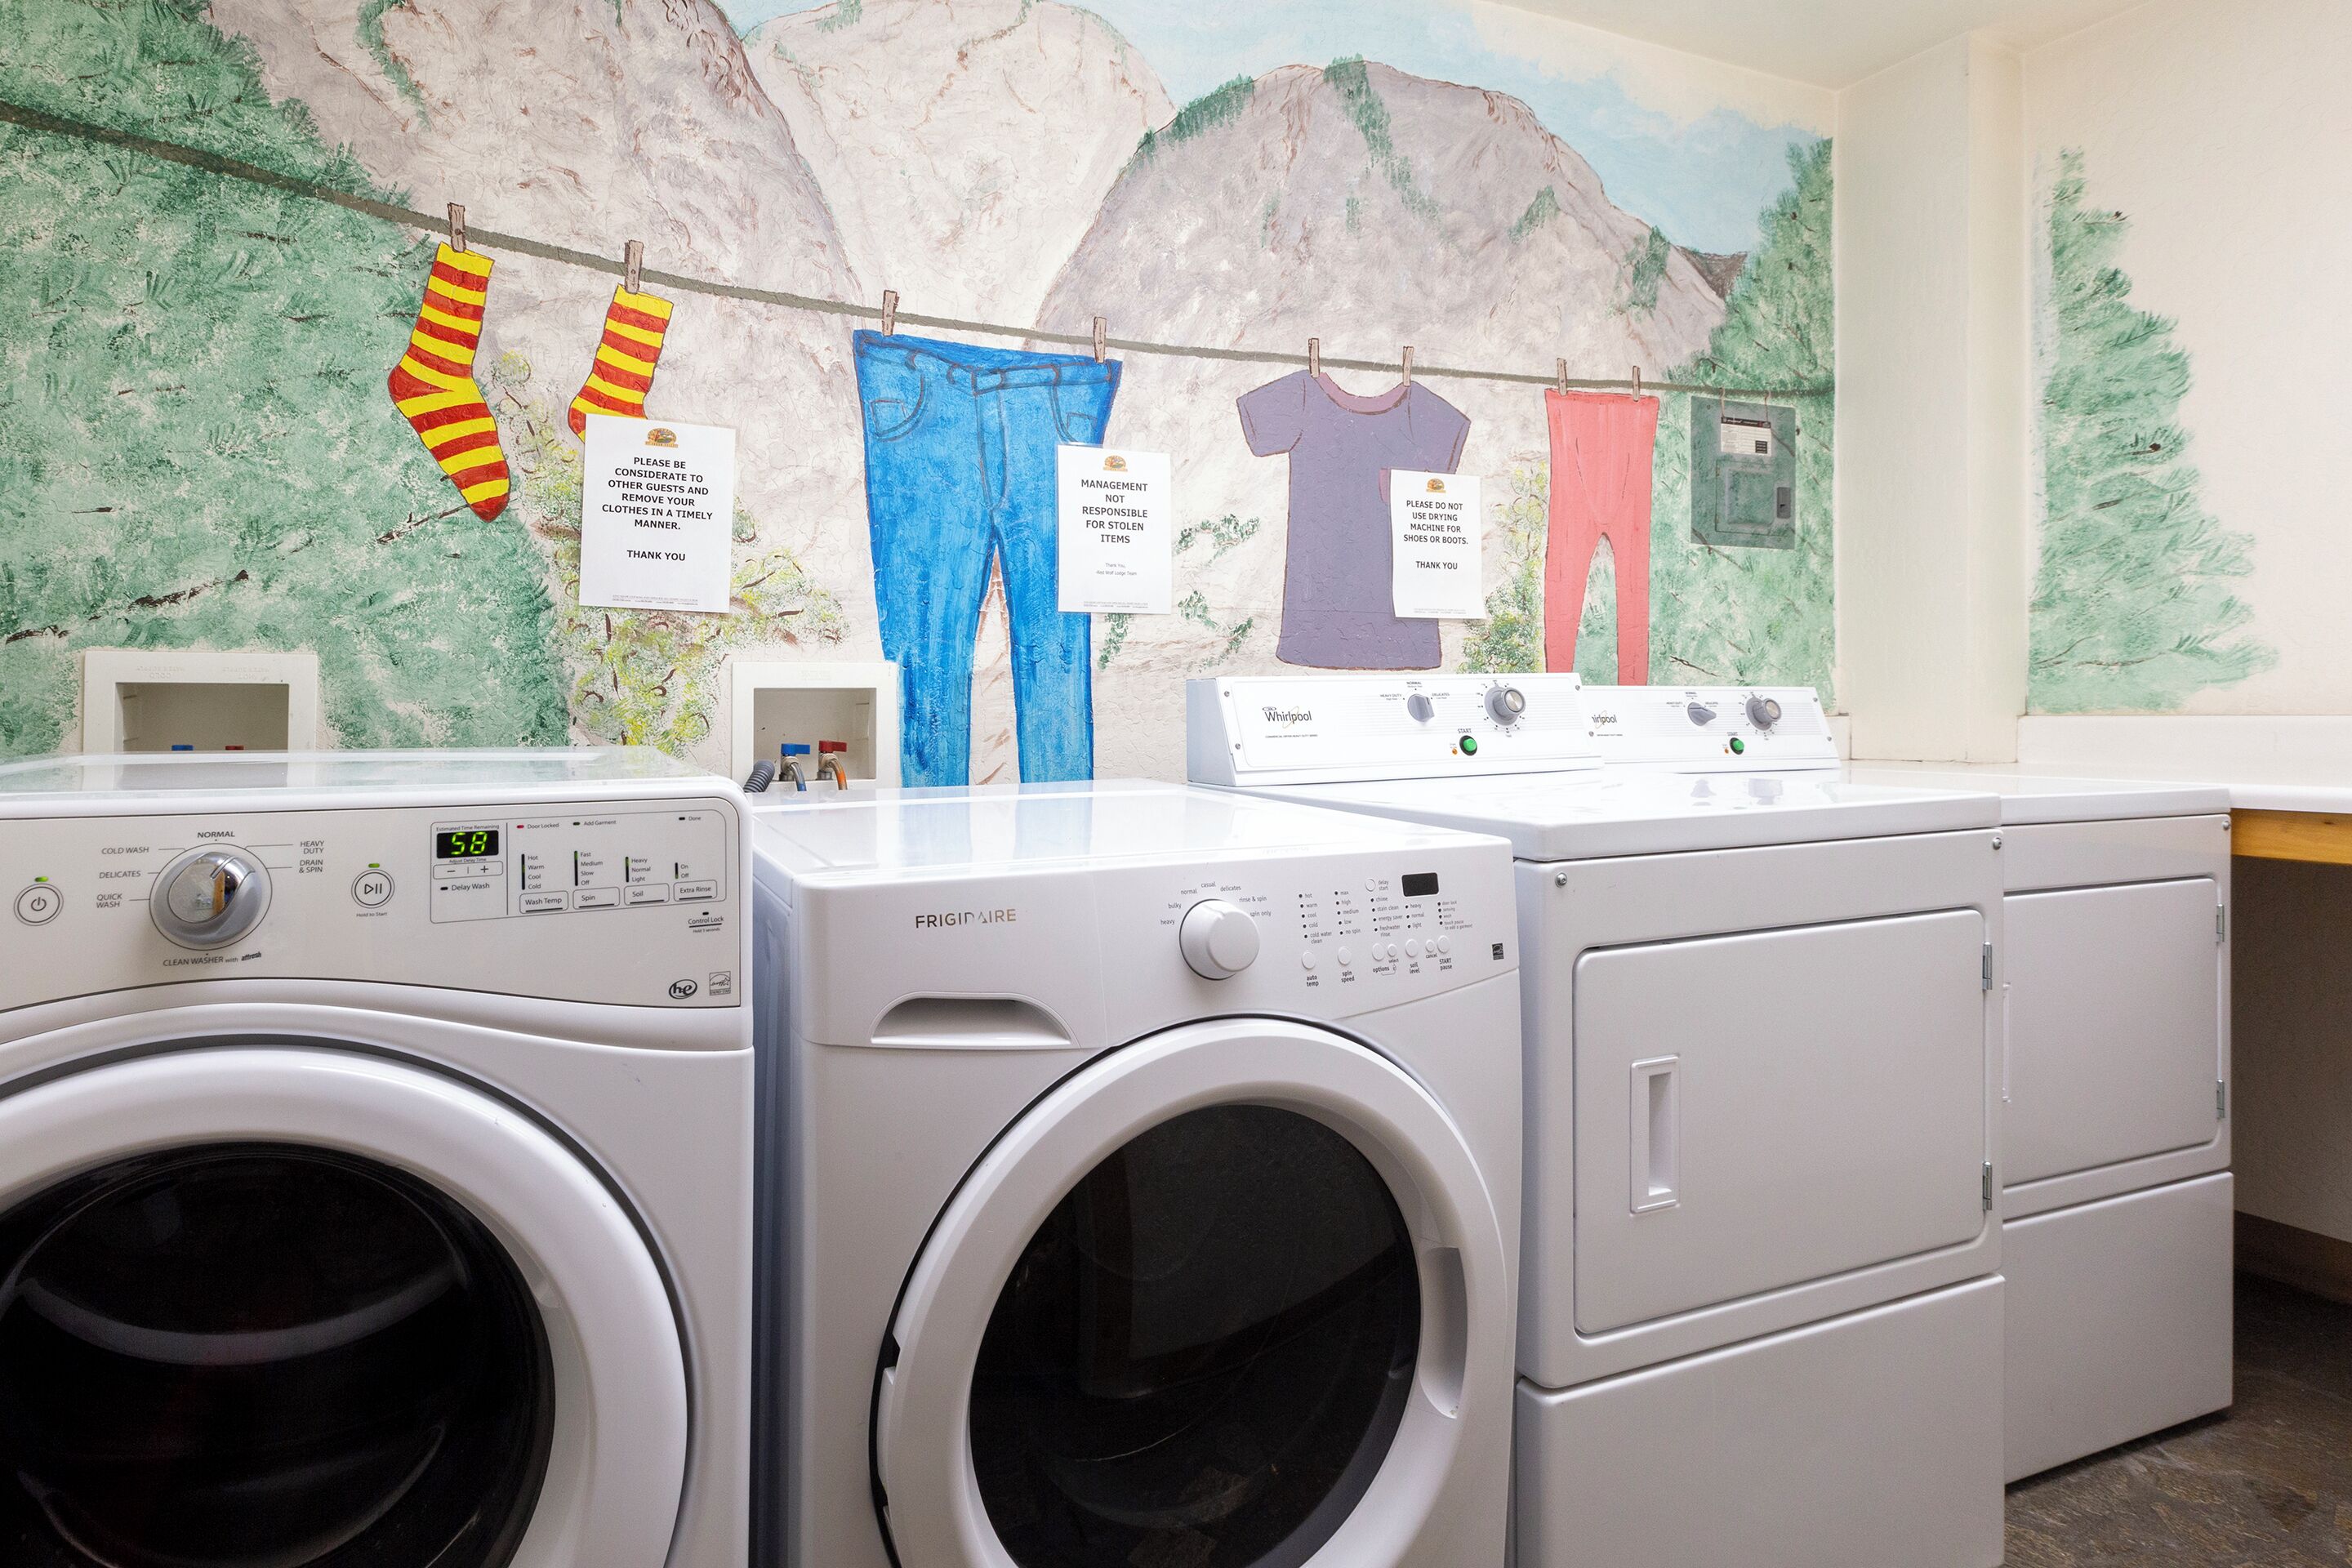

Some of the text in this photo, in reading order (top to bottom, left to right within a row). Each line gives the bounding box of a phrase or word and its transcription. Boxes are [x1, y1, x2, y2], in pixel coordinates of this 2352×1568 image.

[634, 457, 670, 468] PLEASE
[615, 468, 703, 483] CONSIDERATE TO
[608, 480, 709, 495] OTHER GUESTS AND
[1081, 479, 1147, 492] MANAGEMENT
[622, 493, 695, 506] REMOVE YOUR
[1106, 494, 1125, 503] NOT
[1406, 501, 1433, 509] PLEASE
[603, 505, 648, 515] CLOTHES
[652, 508, 663, 516] IN
[676, 510, 713, 520] TIMELY
[1082, 506, 1147, 518] RESPONSIBLE
[1429, 513, 1458, 521] DRYING
[635, 519, 680, 530] MANNER.
[1086, 520, 1143, 531] FOR STOLEN
[1410, 523, 1445, 532] MACHINE
[1101, 534, 1130, 543] ITEMS
[1404, 534, 1428, 542] SHOES
[1442, 537, 1468, 545] BOOTS.
[627, 550, 686, 561] THANK YOU
[1265, 710, 1312, 724] Whirlpool
[451, 832, 488, 855] 58
[99, 871, 141, 879] DELICATES
[915, 909, 1016, 929] FRIGIDAIRE
[191, 956, 224, 964] WASHER
[241, 951, 261, 961] affresh
